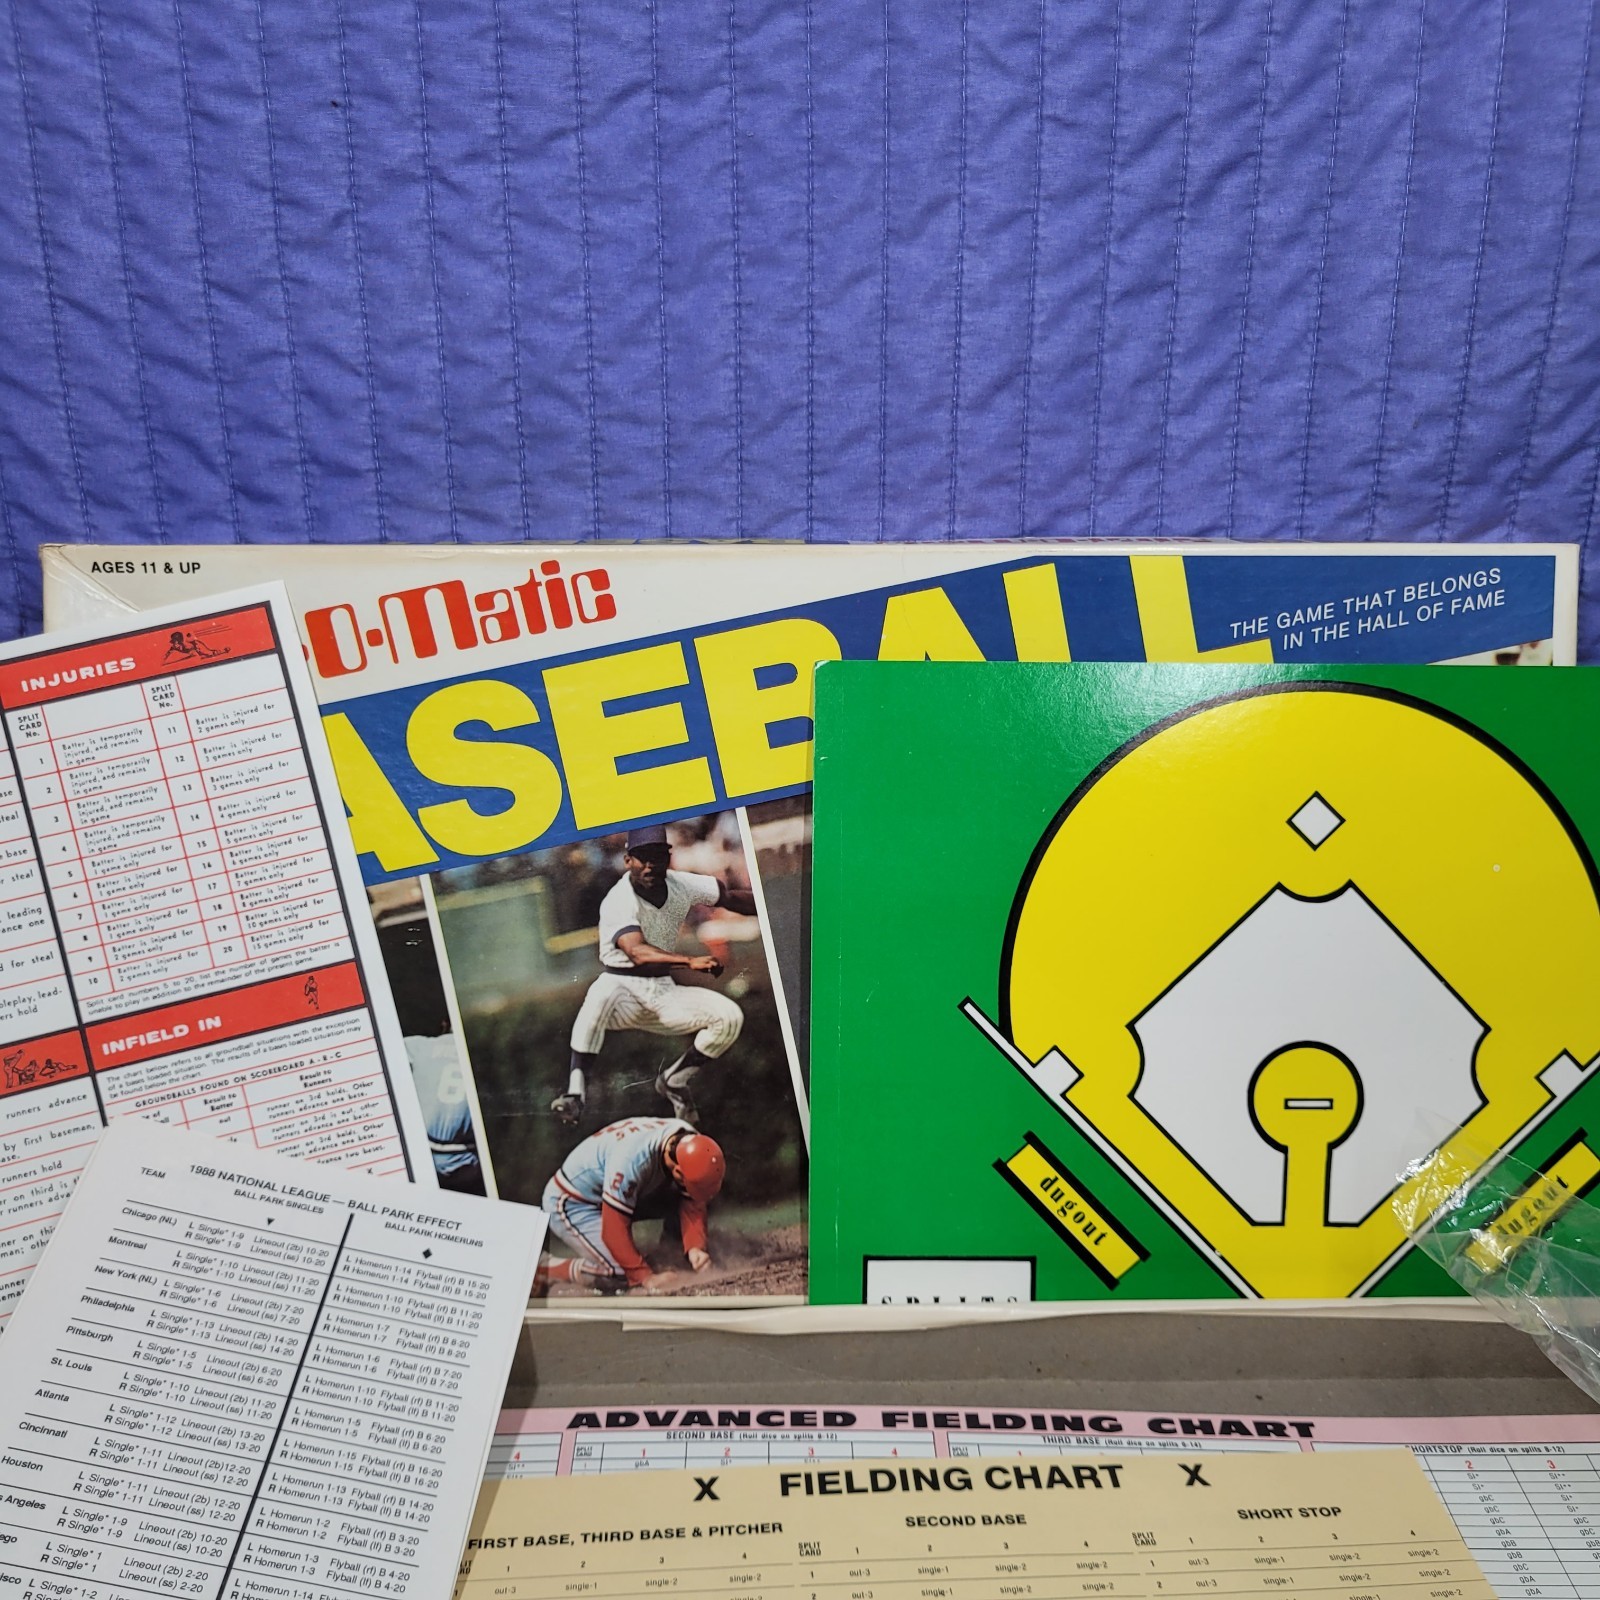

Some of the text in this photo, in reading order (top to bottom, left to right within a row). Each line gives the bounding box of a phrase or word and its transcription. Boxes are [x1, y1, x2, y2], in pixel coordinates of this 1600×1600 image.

[91, 561, 200, 574] AGES 11 & UP
[1229, 567, 1501, 638] THE GAME THAT BELONGS
[1283, 589, 1505, 650] IN THE HALL OF FAME
[20, 657, 136, 692] INJURIES
[150, 683, 171, 693] SPLIT
[152, 691, 174, 701] CARD
[17, 712, 38, 723] SPLIT
[18, 720, 42, 731] CARD
[5, 849, 27, 858] base
[11, 869, 33, 882] steal
[7, 907, 42, 919] leading
[10, 951, 53, 968] for steal
[102, 1015, 221, 1055] INFIELD IN
[233, 1075, 246, 1083] ON
[6, 1094, 86, 1119] runners advance
[3, 1124, 94, 1152] by first baseman,
[1, 1160, 62, 1183] runners hold
[141, 1166, 166, 1178] TEAM
[190, 1164, 216, 1177] 1988
[217, 1170, 277, 1191] NATIONAL
[281, 1185, 330, 1202] LEAGUE
[347, 1199, 376, 1213] BALL
[381, 1206, 414, 1220] PARK
[416, 1214, 462, 1230] EFFECT
[233, 1188, 324, 1214] BALL PARK SINGLES
[121, 1206, 177, 1226] Chicago (NL)
[1038, 1172, 1108, 1248] dugout
[384, 1221, 483, 1247] BALL PARK HOMERUNS
[108, 1235, 147, 1250] Montreal
[94, 1264, 157, 1285] New York (NL)
[80, 1294, 135, 1312] Philadelphia
[65, 1325, 113, 1342] Pittsburgh
[50, 1356, 92, 1371] St. Louis
[34, 1388, 69, 1402] Atlanta
[18, 1421, 68, 1438] Cincinnati
[566, 1409, 1316, 1440] ADVANCED FIELDING CHART
[666, 1429, 734, 1439] SECOND BASE
[1041, 1434, 1071, 1444] THIRD
[1075, 1434, 1100, 1445] BASE
[1404, 1444, 1463, 1453] HORTSTOP
[0, 1455, 43, 1471] Houston
[1547, 1460, 1556, 1469] 3
[693, 1463, 1210, 1501] X FIELDING CHART X
[271, 1472, 277, 1480] L
[282, 1474, 324, 1490] Homerun
[327, 1483, 346, 1494] 1-13
[351, 1487, 381, 1501] Flyball
[398, 1496, 406, 1506] B
[409, 1500, 434, 1512] 14-20
[4, 1494, 46, 1510] Angeles
[72, 1482, 82, 1491] R
[122, 1492, 143, 1504] 1-11
[148, 1497, 185, 1512] Lineout
[186, 1505, 205, 1518] (ss)
[209, 1510, 236, 1522] 12-20
[1237, 1506, 1341, 1519] SHORT STOP
[61, 1506, 68, 1515] L
[112, 1516, 128, 1526] 1-9
[138, 1520, 176, 1536] Lineout
[176, 1528, 197, 1541] (2b)
[200, 1533, 228, 1546] 10-20
[259, 1506, 265, 1515] L
[270, 1509, 312, 1525] Homerun
[316, 1518, 330, 1528] 1-2
[340, 1522, 371, 1536] Flyball
[388, 1532, 396, 1541] B
[398, 1534, 419, 1546] 3-20
[905, 1514, 1026, 1527] SECOND BASE
[466, 1522, 782, 1551] FIRST BASE, THIRD BASE & PITCHER
[798, 1542, 822, 1550] SPLIT
[798, 1548, 822, 1556] CARD
[1328, 1551, 1360, 1562] single-2
[1408, 1548, 1440, 1558] single-2
[1076, 1560, 1108, 1570] single-2
[1188, 1558, 1209, 1567] out-3
[1254, 1555, 1285, 1566] single-1
[849, 1568, 870, 1577] out-3
[917, 1566, 949, 1576] single-1
[994, 1562, 1027, 1573] single-2
[645, 1578, 678, 1588] single-2
[729, 1572, 762, 1584] single-2
[494, 1586, 517, 1596] out-3
[565, 1581, 598, 1592] single-1
